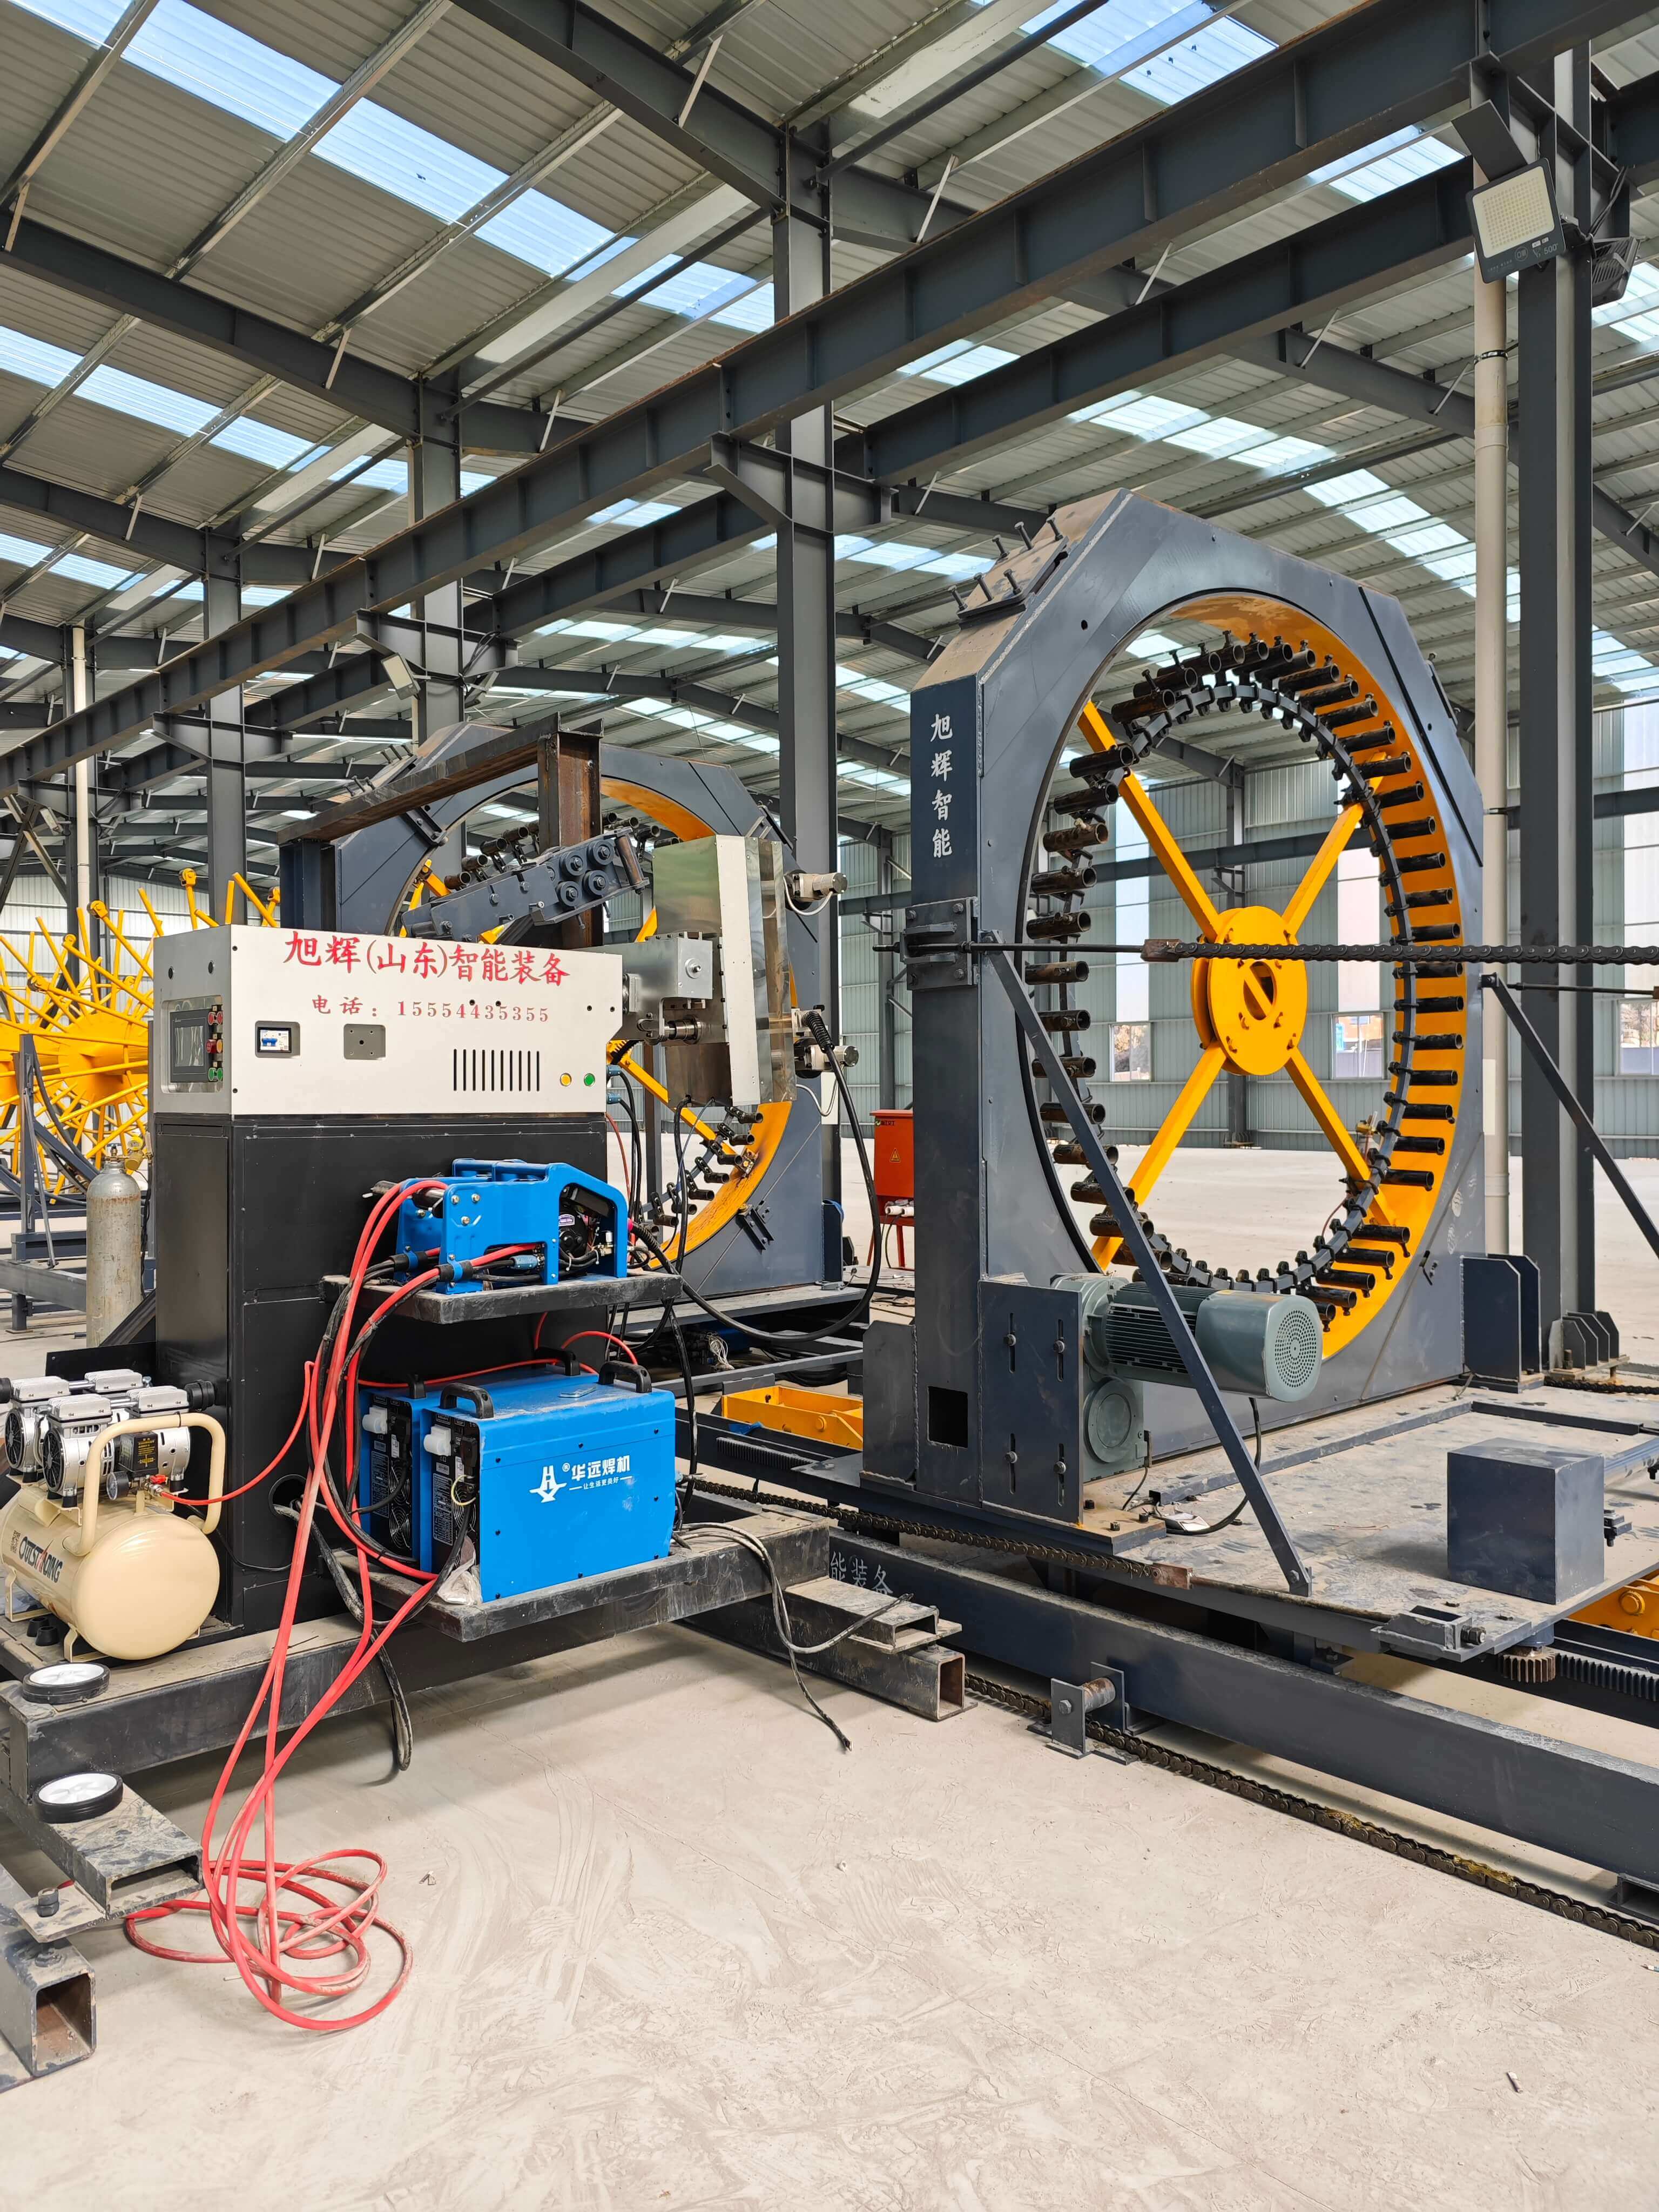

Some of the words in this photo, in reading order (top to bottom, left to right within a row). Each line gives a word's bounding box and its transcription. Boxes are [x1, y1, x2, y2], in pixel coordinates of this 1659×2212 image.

[930, 713, 953, 858] 旭辉智能
[283, 931, 570, 986] 旭辉(山东)智能装备
[571, 1455, 630, 1481] 华远焊机
[583, 1477, 620, 1490] 让生活更美好
